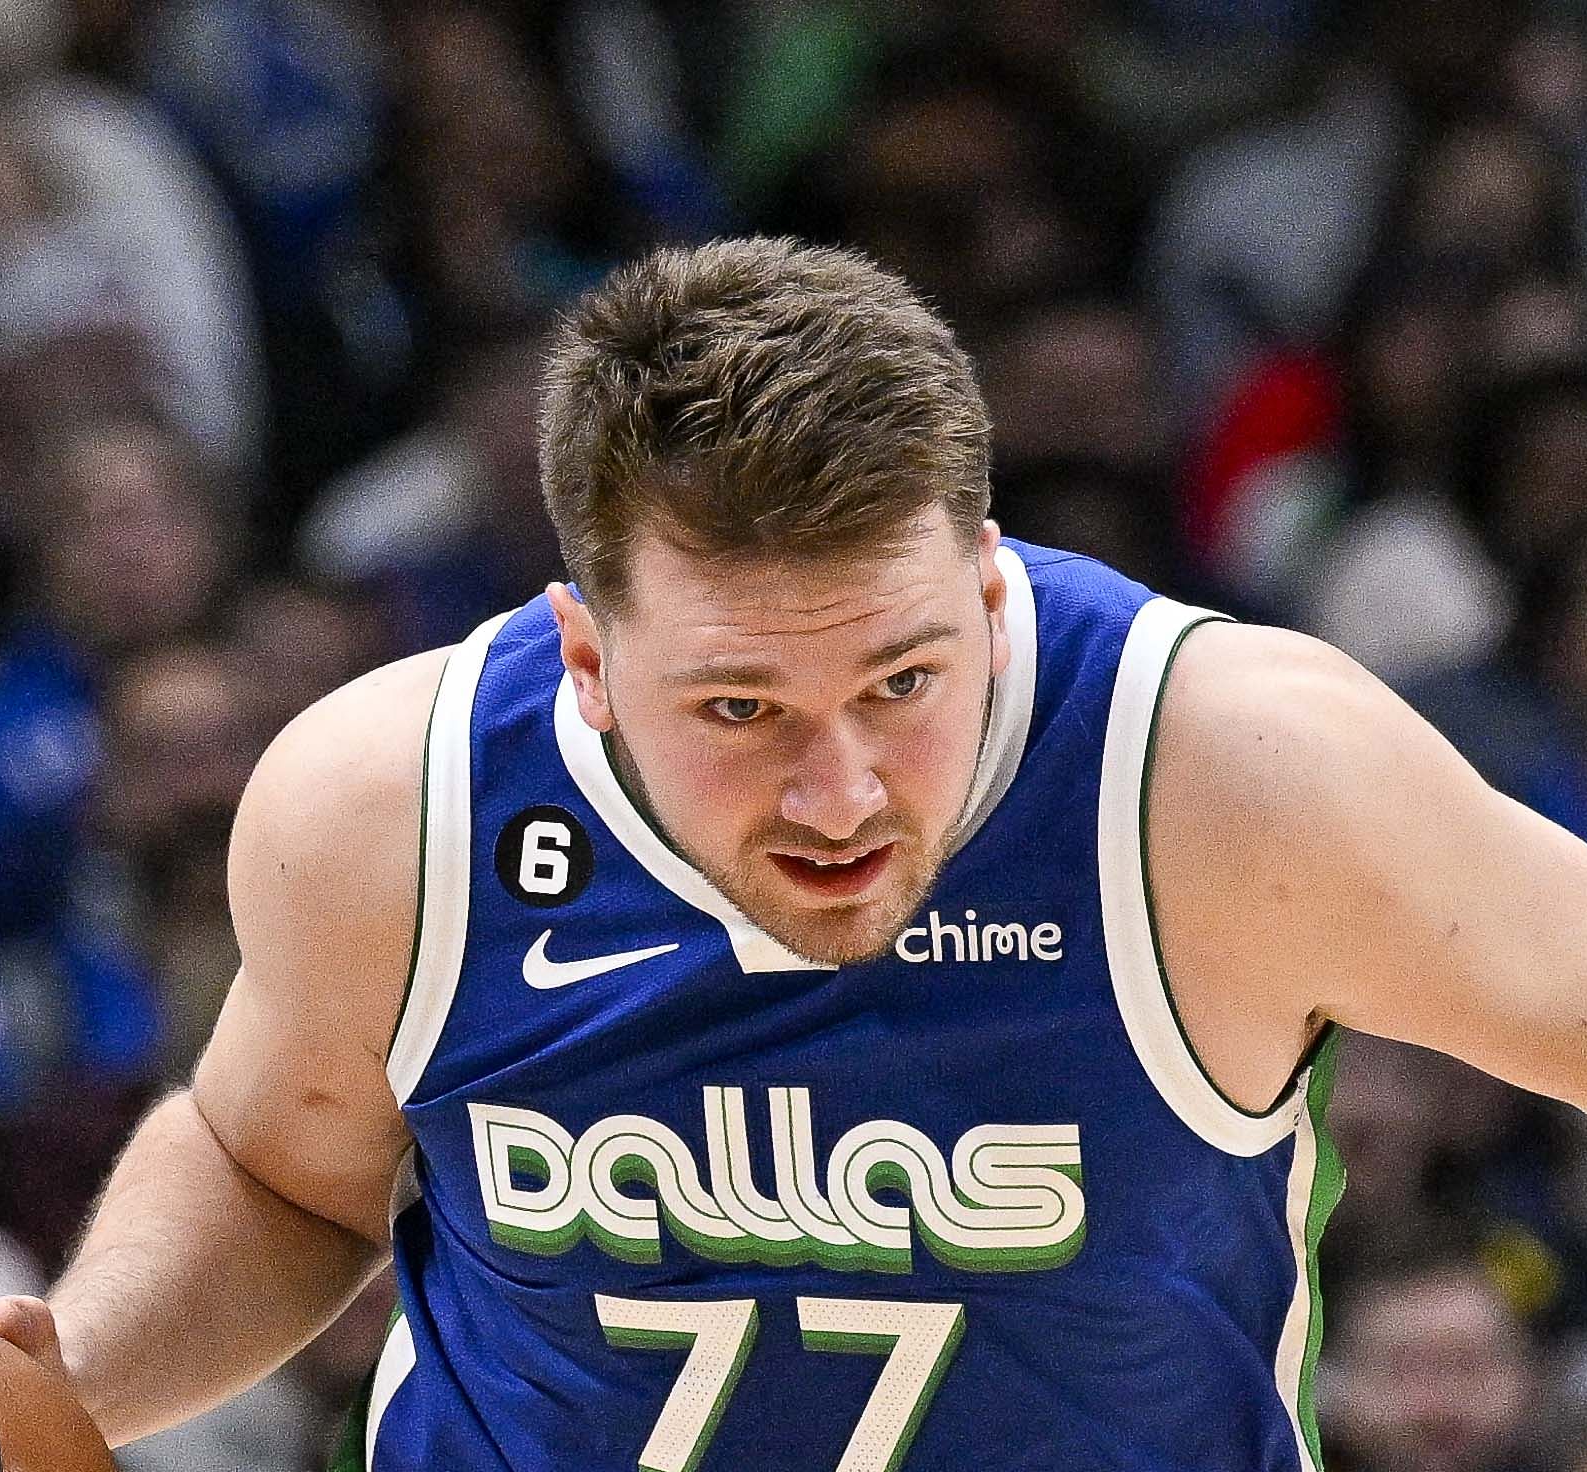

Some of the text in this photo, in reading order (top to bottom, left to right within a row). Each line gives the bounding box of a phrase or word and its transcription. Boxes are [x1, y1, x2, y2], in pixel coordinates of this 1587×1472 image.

[518, 820, 571, 895] 6
[895, 910, 1063, 963] chime
[468, 1085, 1087, 1273] Dallas
